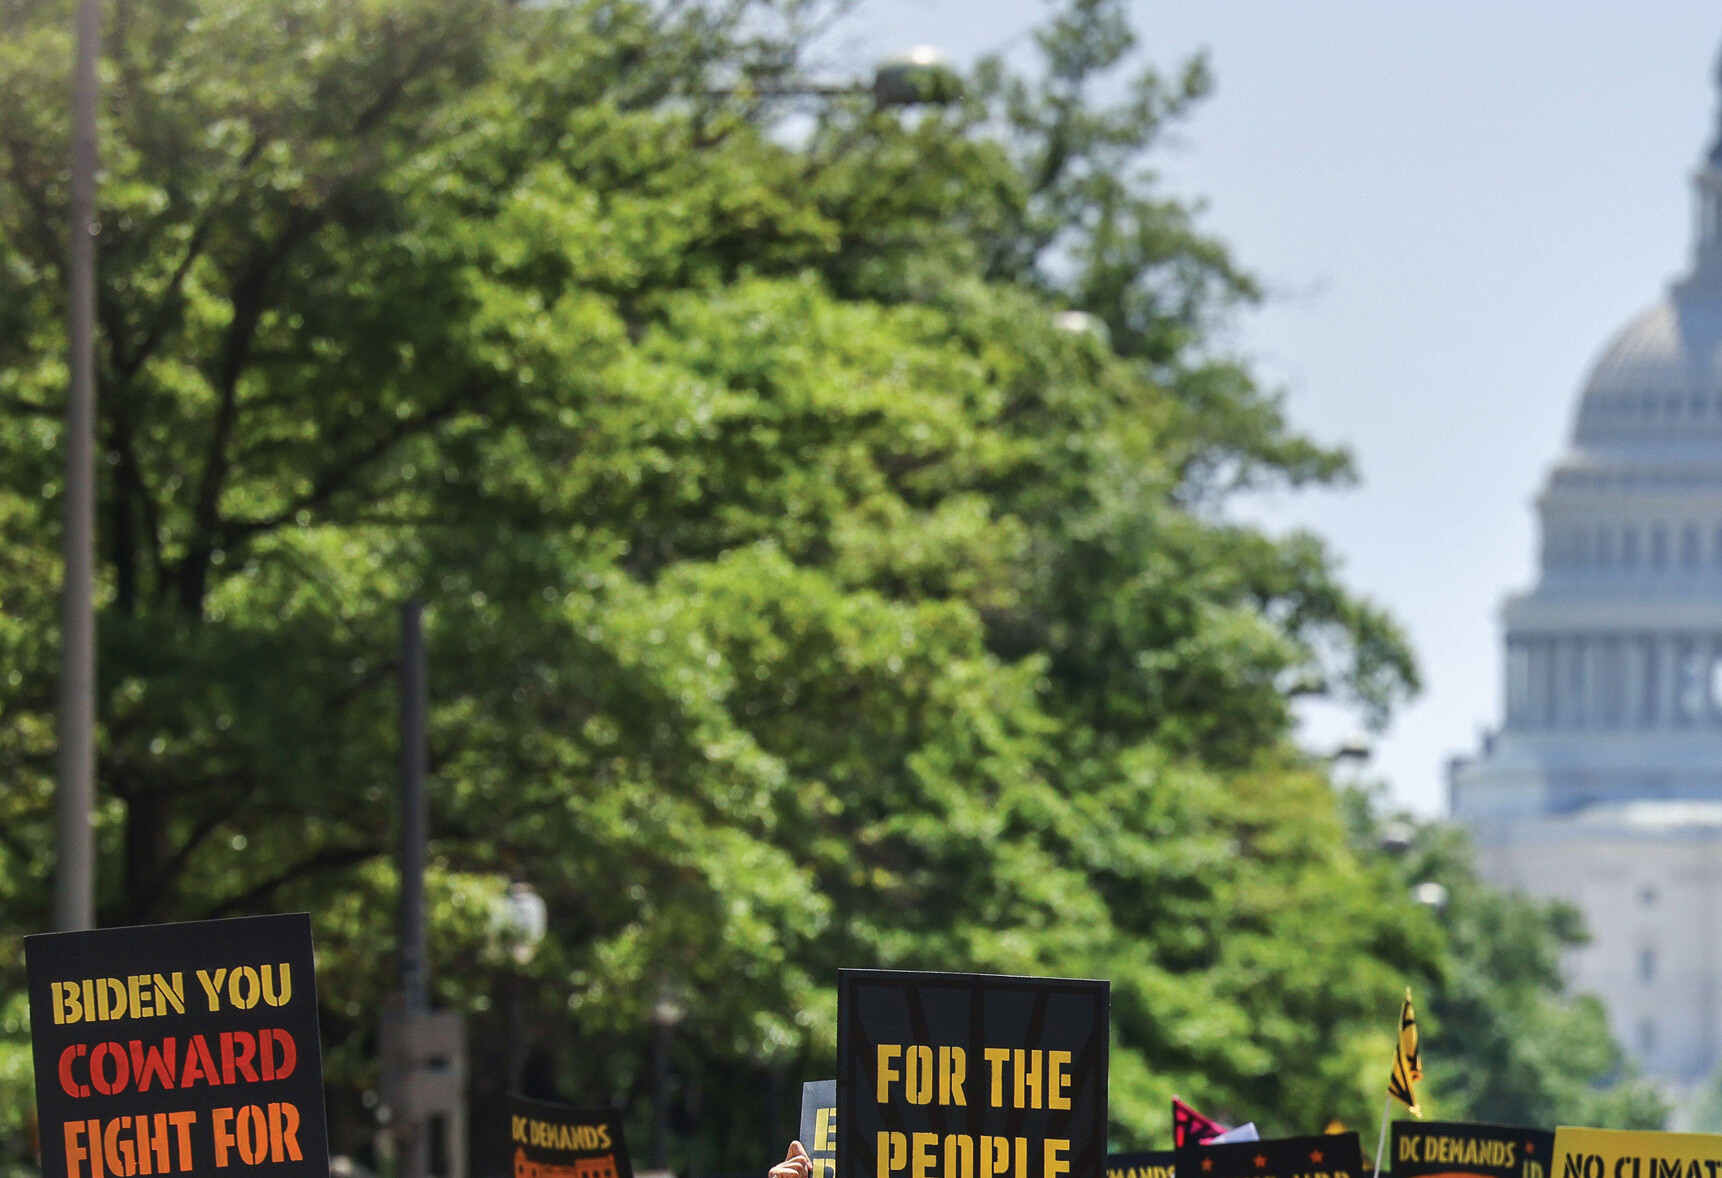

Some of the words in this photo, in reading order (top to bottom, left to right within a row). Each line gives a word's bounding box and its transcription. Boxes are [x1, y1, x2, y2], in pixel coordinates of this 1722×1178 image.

[51, 972, 186, 1025] BIDEN
[197, 962, 292, 1012] YOU
[58, 1028, 298, 1098] COWARD
[877, 1044, 967, 1106] FOR
[984, 1048, 1072, 1110] THE
[213, 1102, 303, 1168] FOR
[512, 1115, 528, 1143] DC
[530, 1119, 611, 1150] DEMANDS
[1400, 1136, 1420, 1162] DC
[1424, 1136, 1516, 1167] DEMANDS
